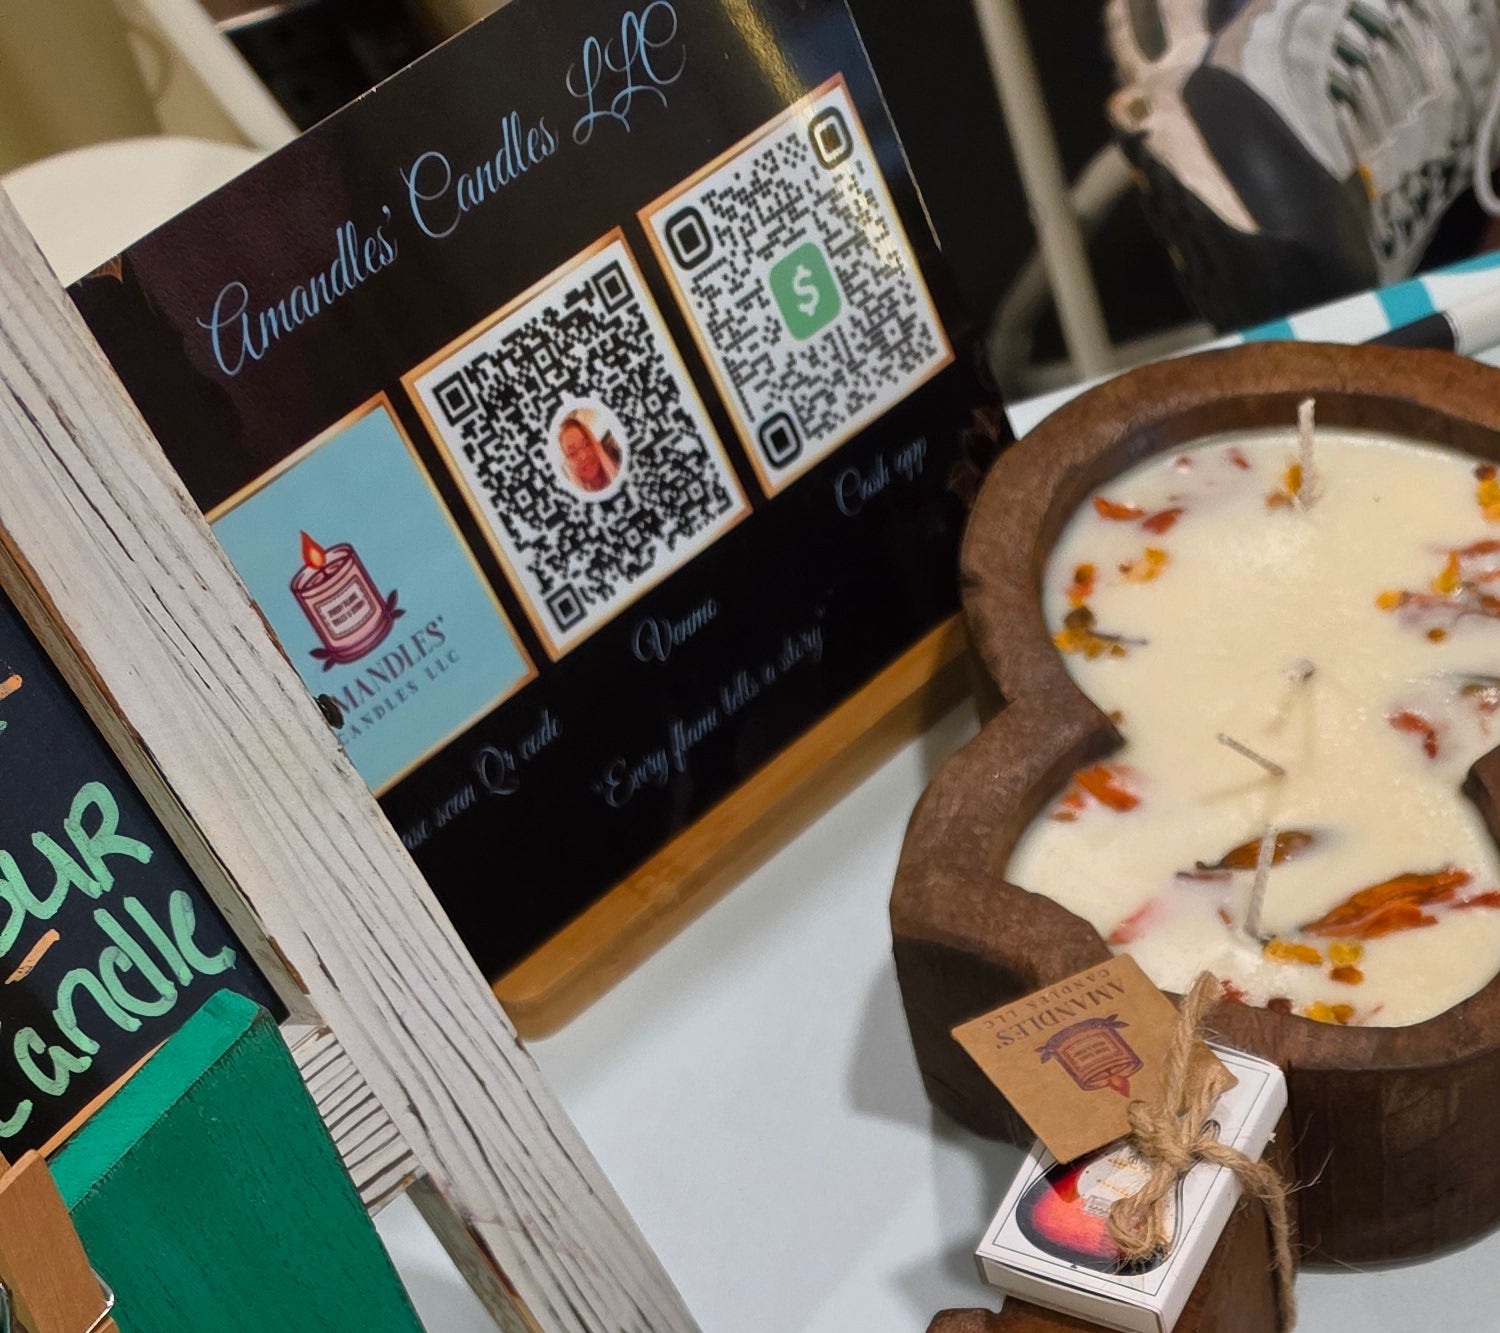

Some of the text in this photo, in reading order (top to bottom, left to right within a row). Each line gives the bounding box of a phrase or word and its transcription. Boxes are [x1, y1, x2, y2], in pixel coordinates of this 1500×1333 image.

[197, 1, 686, 377] Amandles' Candles LLC
[328, 614, 447, 716] MANDLES'
[423, 650, 460, 681] LLC
[633, 599, 721, 662] Venmo
[996, 977, 1127, 1051] AMANDLES'
